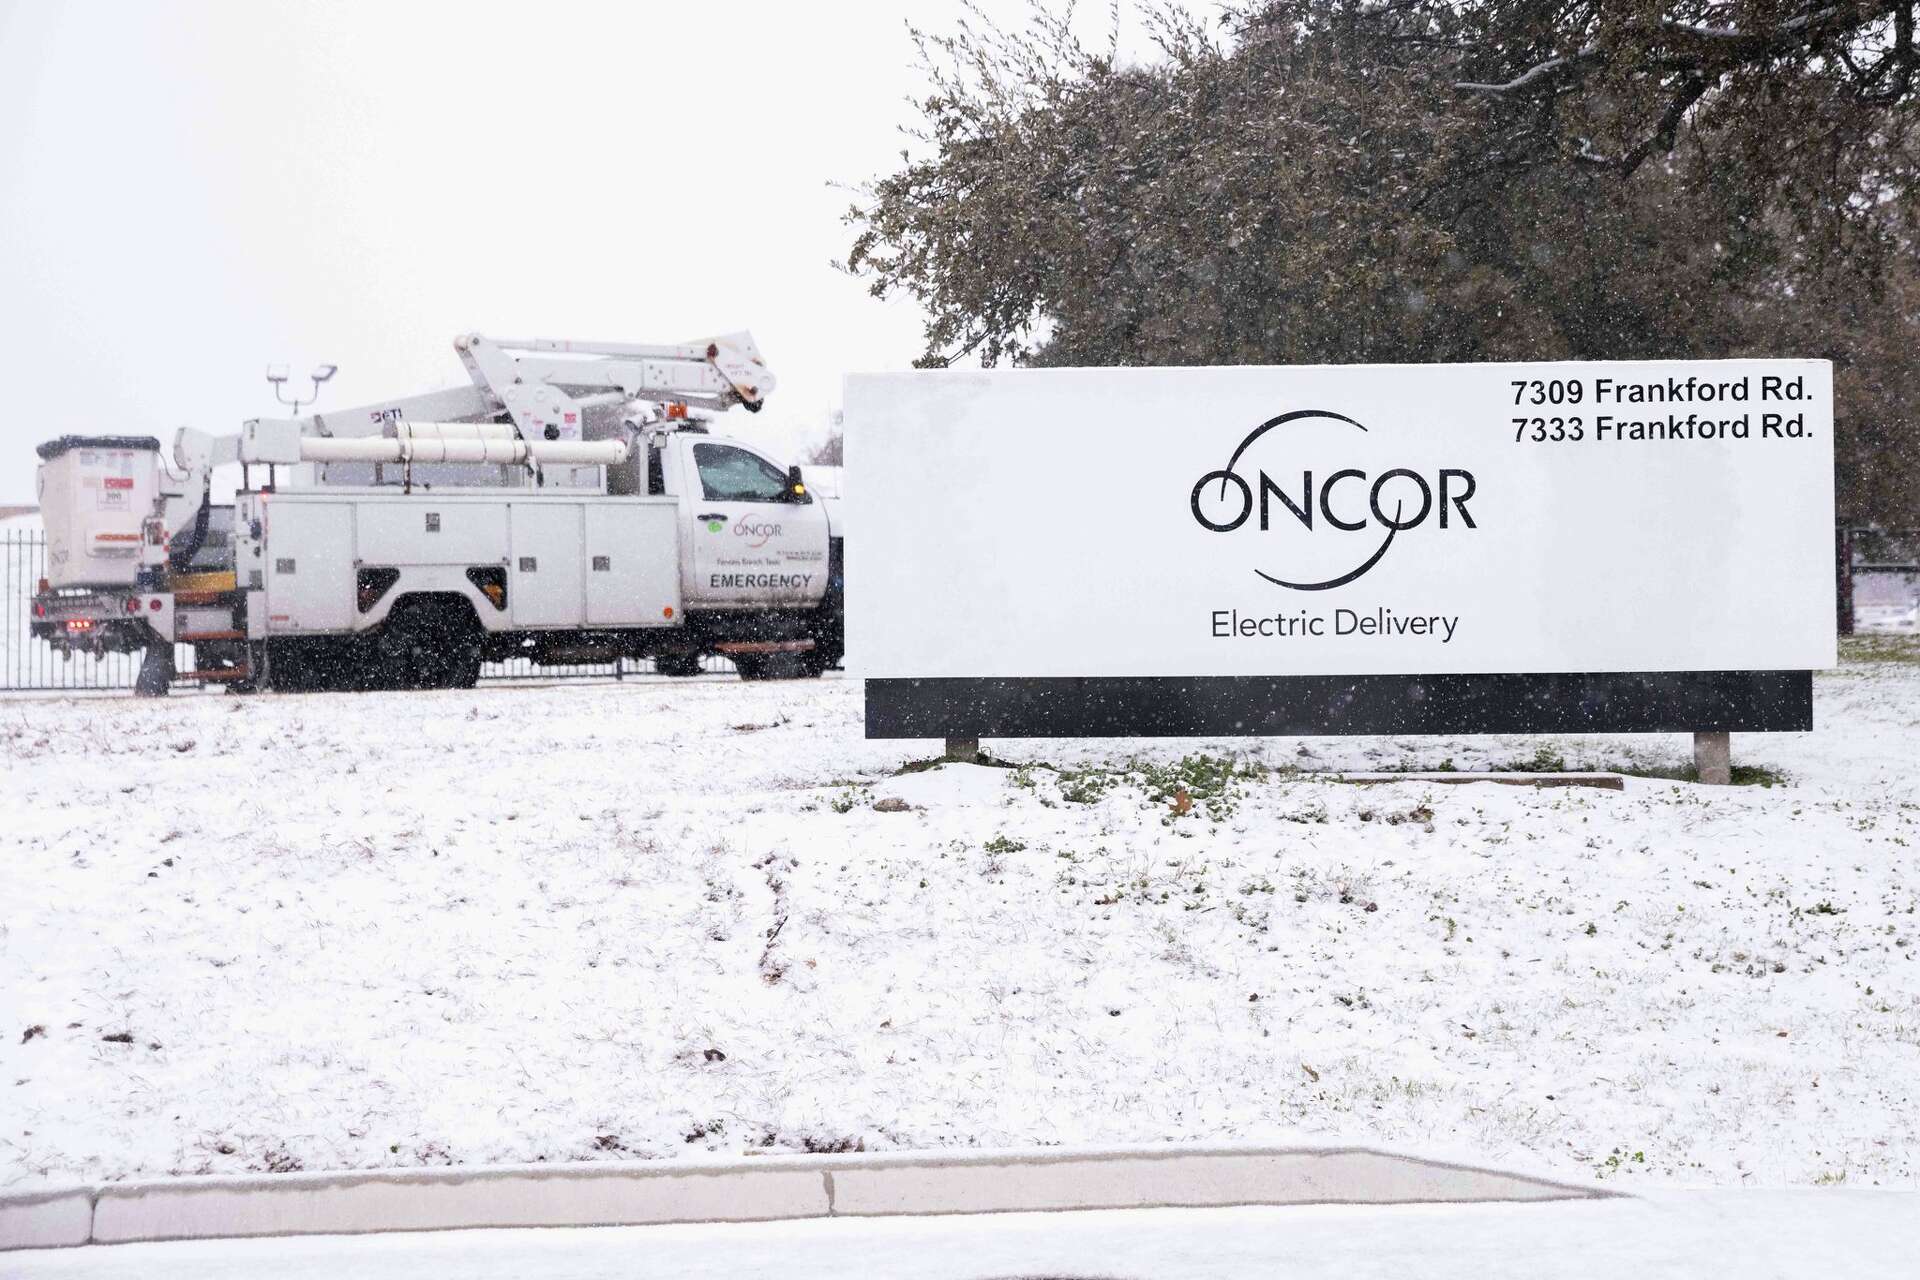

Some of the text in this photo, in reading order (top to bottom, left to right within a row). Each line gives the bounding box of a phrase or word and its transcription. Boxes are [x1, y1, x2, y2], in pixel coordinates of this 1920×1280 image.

[1512, 376, 1813, 405] 7309 Frankford Rd.
[1512, 413, 1813, 443] 7333 Frankford Rd.
[1191, 468, 1478, 531] ONCOR
[734, 523, 782, 537] ONCOR
[710, 574, 812, 588] EMERGENCY
[1213, 607, 1460, 643] Electric Delivery
